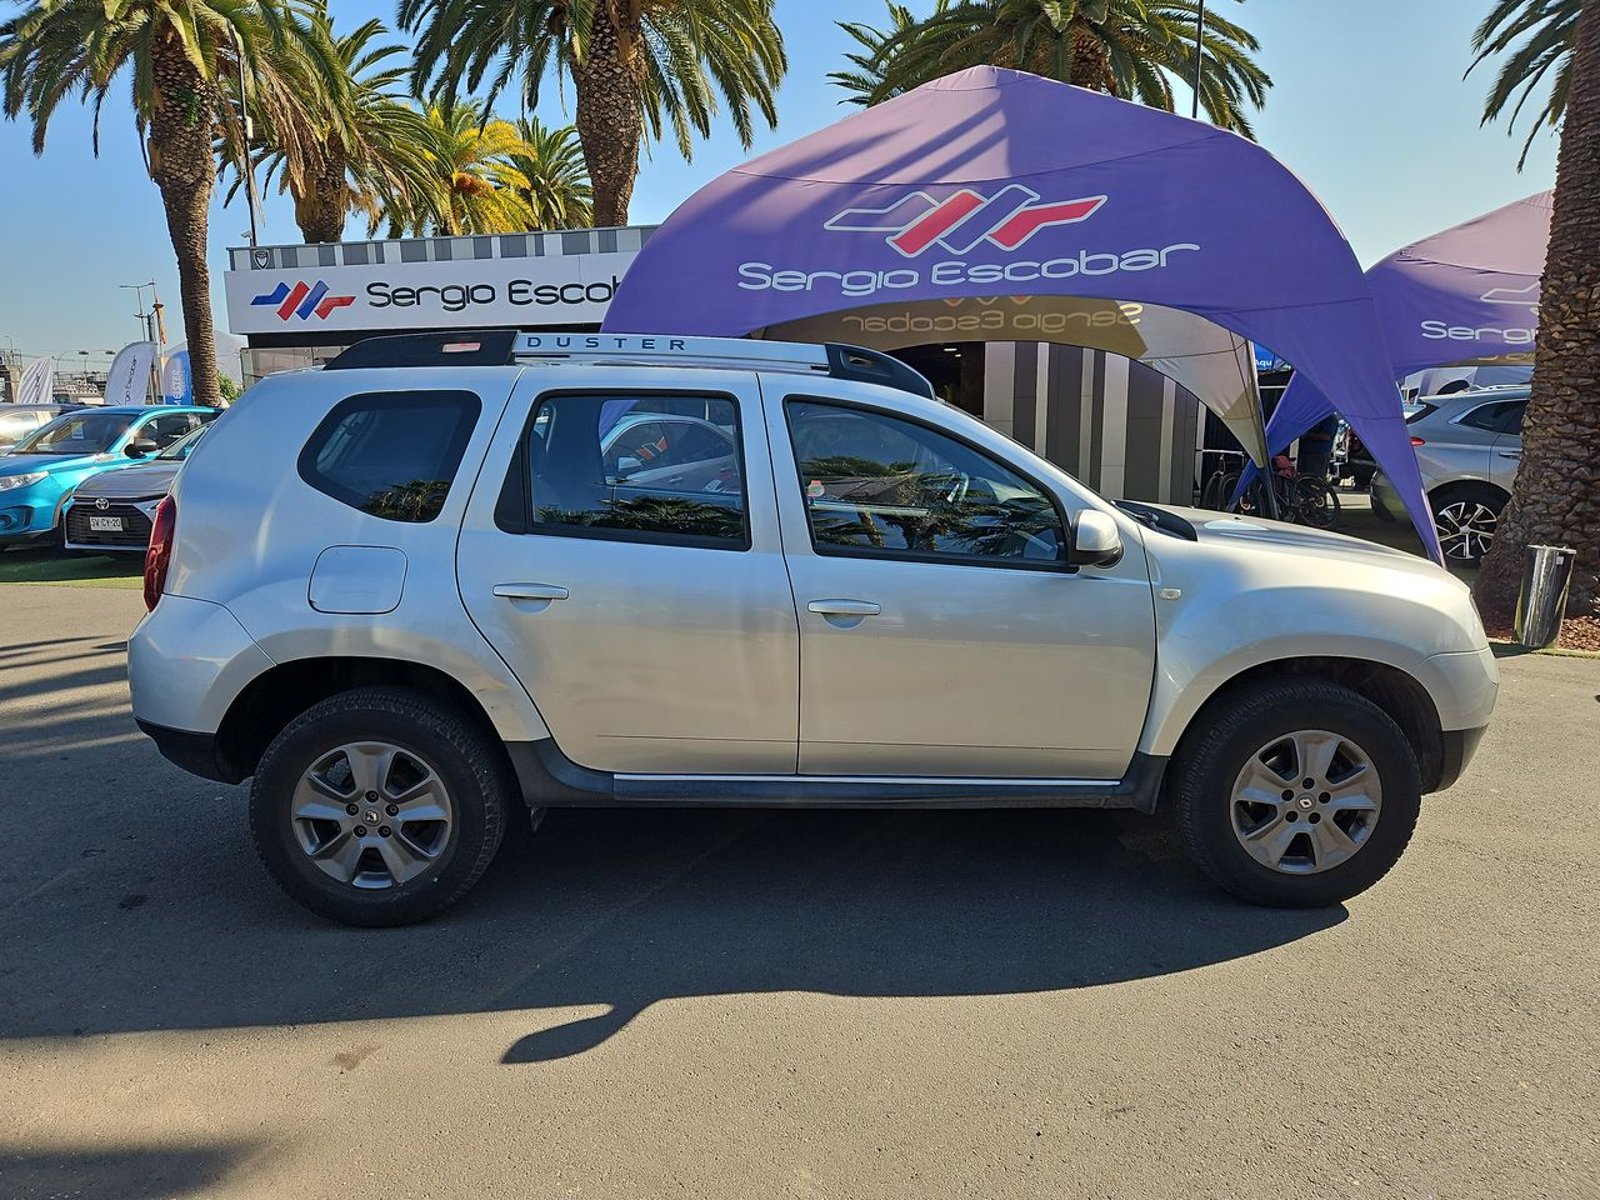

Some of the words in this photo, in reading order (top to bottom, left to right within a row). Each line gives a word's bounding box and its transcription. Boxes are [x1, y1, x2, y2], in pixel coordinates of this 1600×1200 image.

[738, 262, 919, 296] Sergio
[931, 243, 1200, 284] Escobar
[366, 282, 496, 312] Sergio
[508, 275, 620, 305] Esco
[527, 337, 686, 350] DUSTER
[1420, 320, 1536, 345] Sergi
